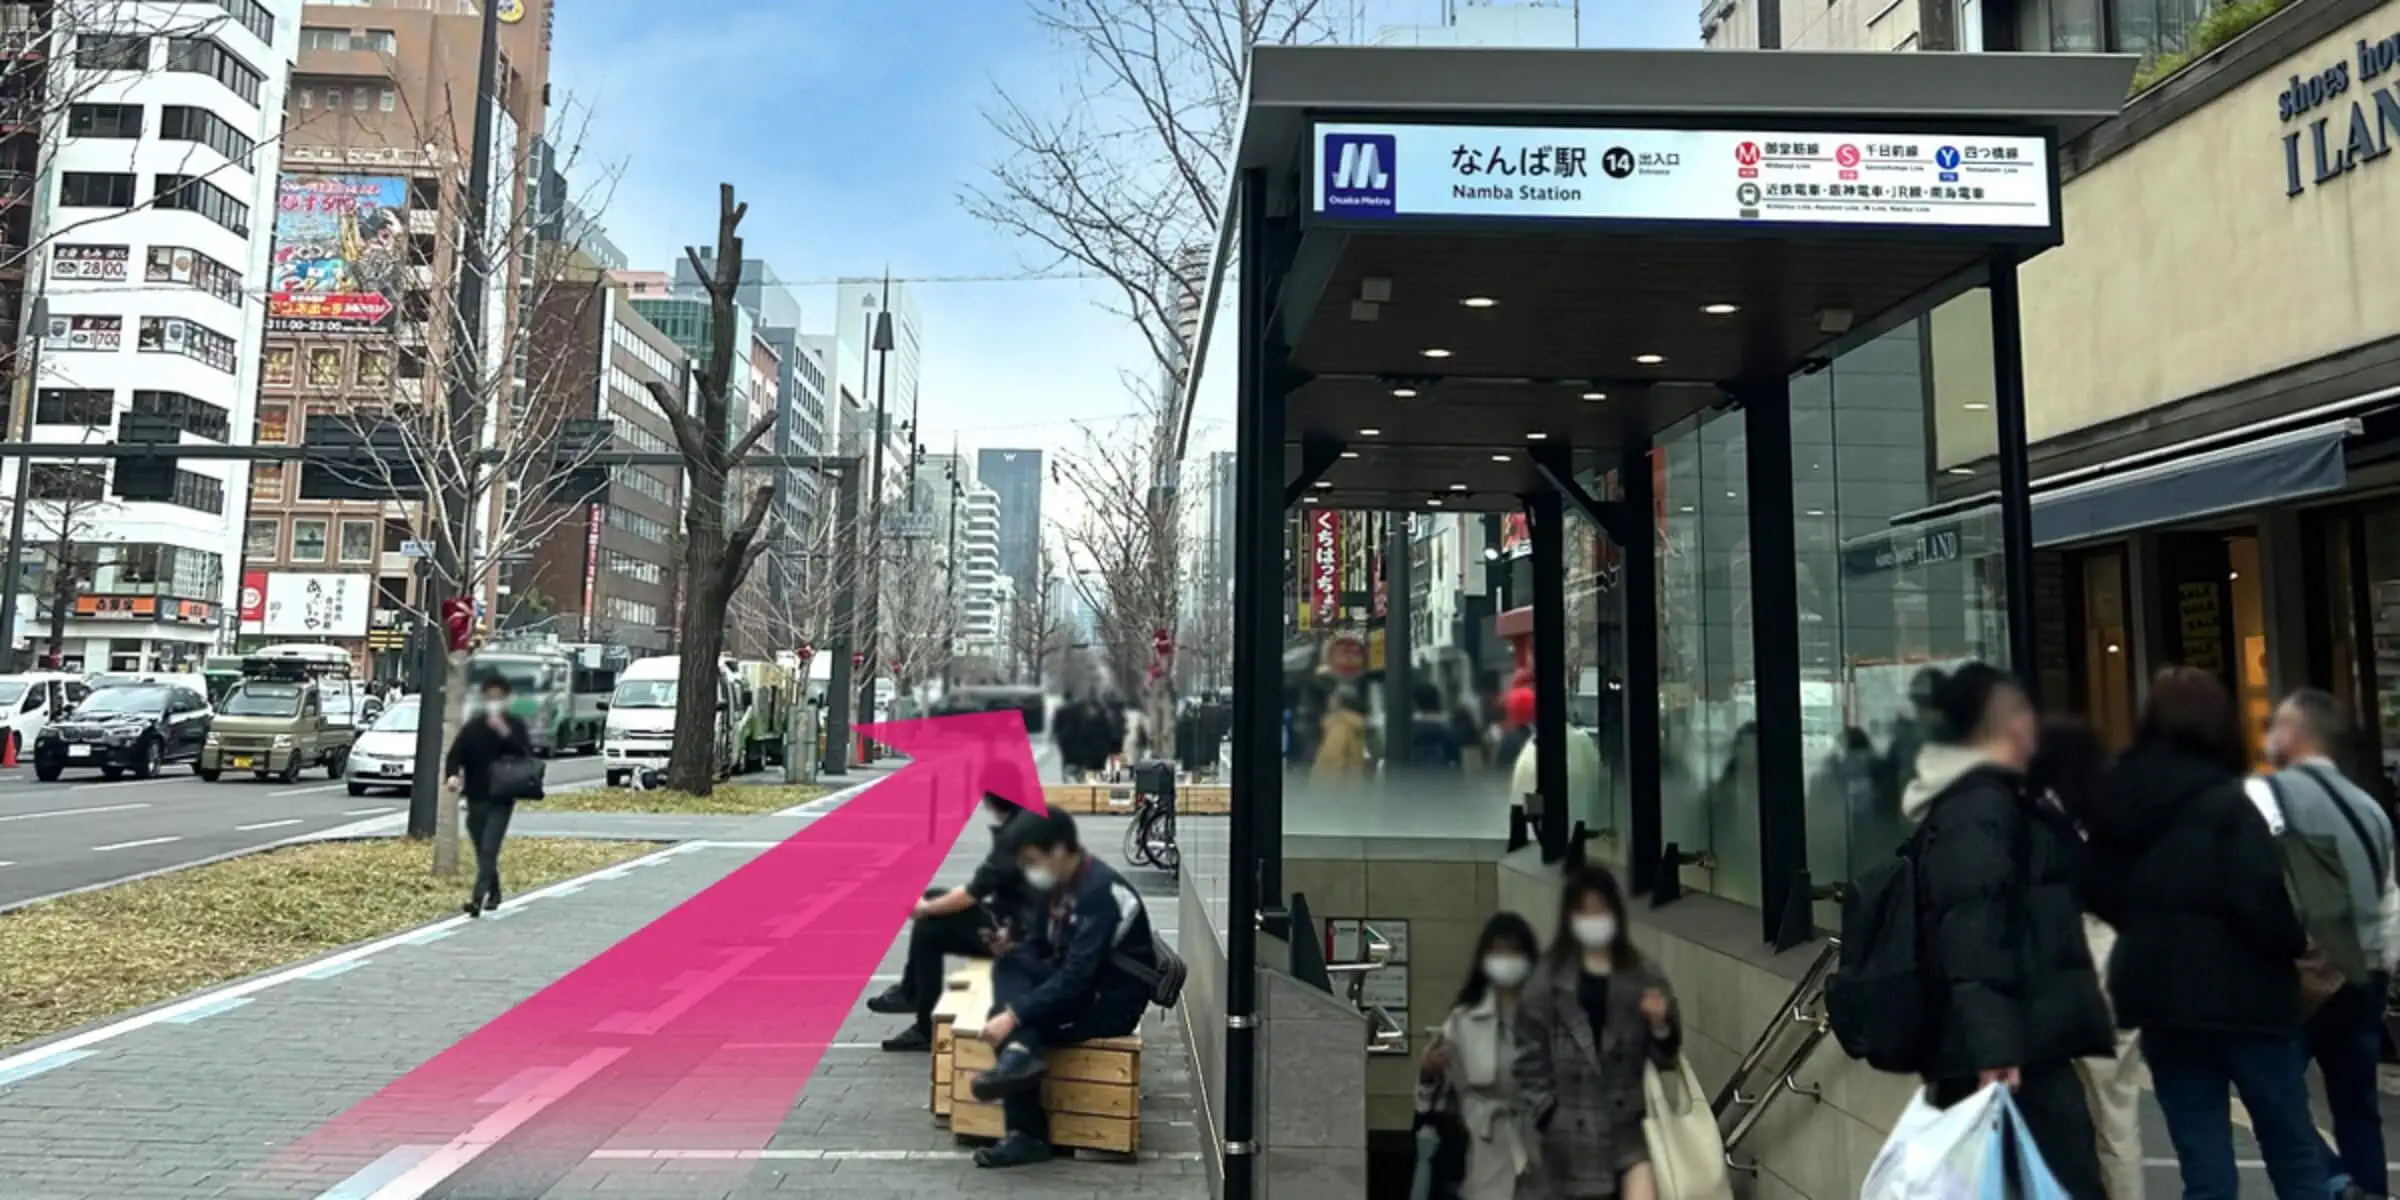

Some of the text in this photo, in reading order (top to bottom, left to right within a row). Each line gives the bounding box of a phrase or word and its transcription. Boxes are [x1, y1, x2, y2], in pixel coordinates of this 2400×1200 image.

[2278, 60, 2349, 122] shoes
[1452, 144, 1588, 178] なんば駅
[1606, 152, 1631, 172] 14
[1638, 152, 1680, 166] 出入口
[1739, 145, 1758, 163] M
[1453, 184, 1581, 201] Namba Station
